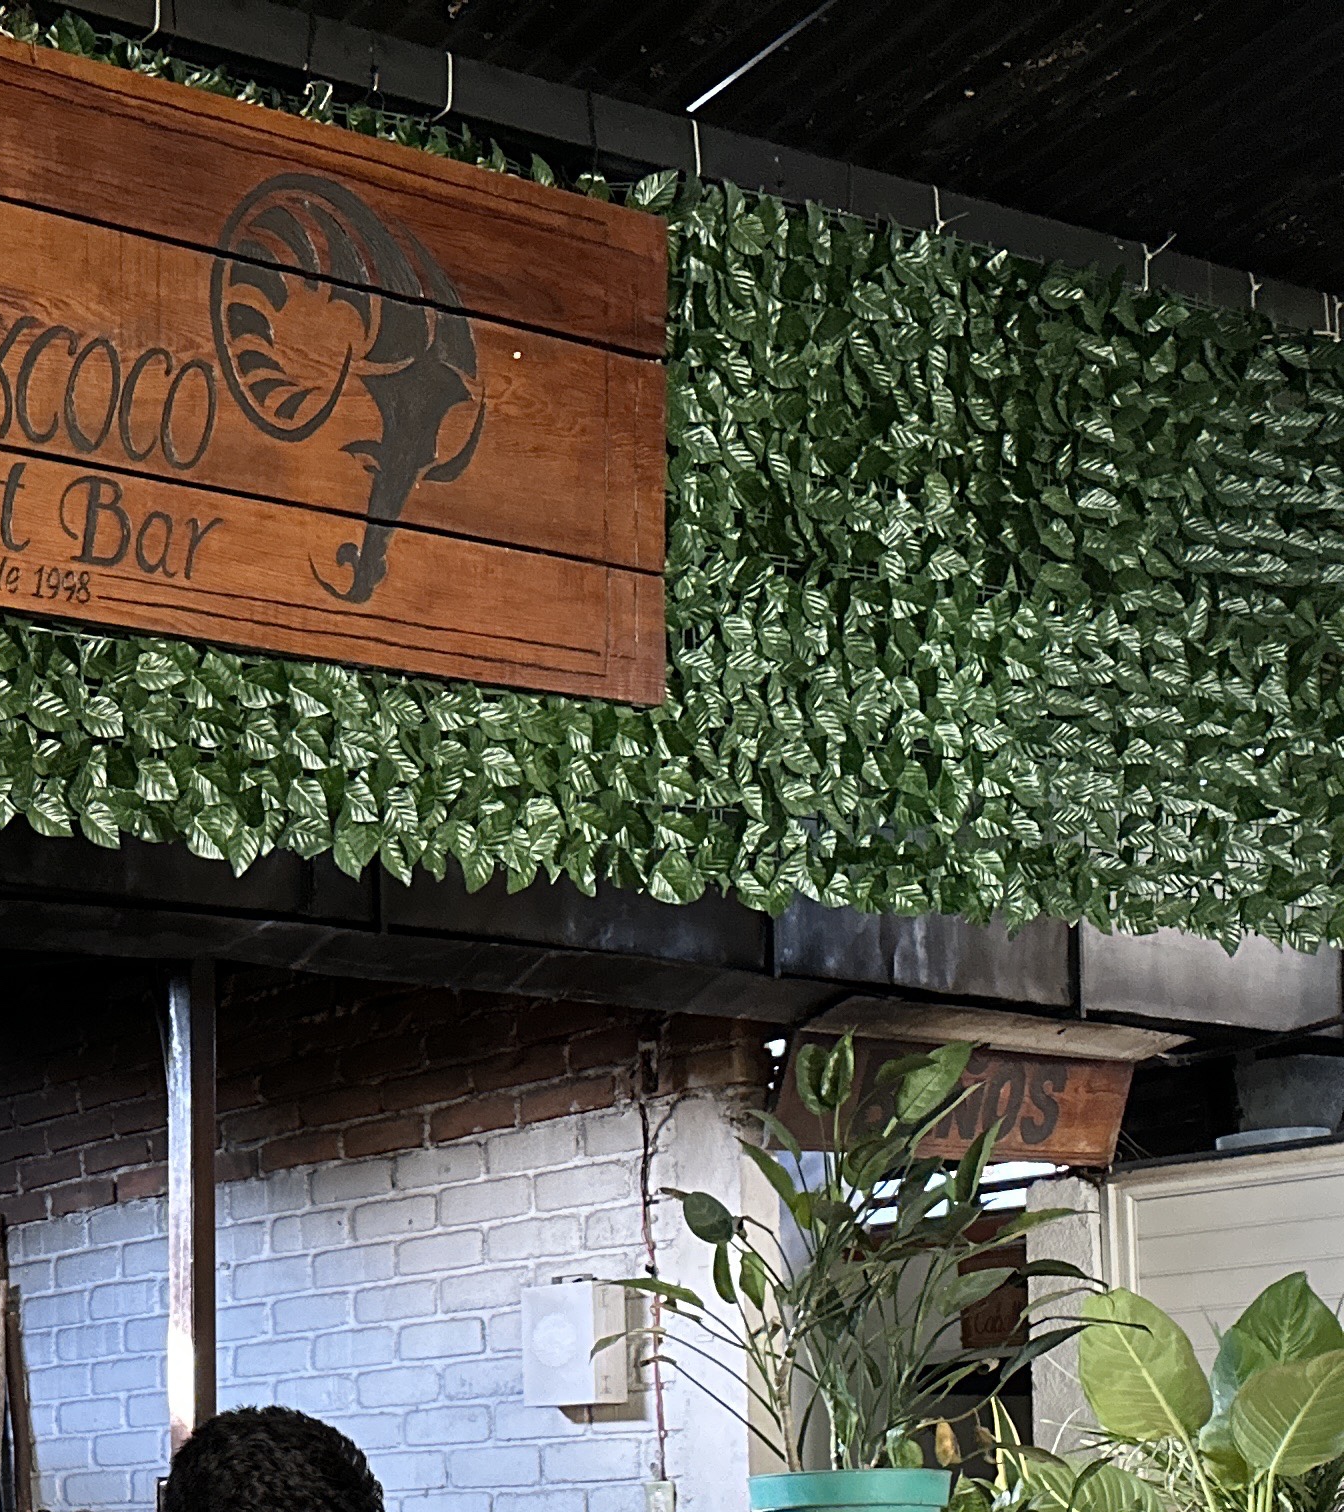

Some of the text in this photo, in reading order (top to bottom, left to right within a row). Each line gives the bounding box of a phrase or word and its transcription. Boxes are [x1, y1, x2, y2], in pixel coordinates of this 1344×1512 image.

[60, 473, 223, 583] Bar
[31, 564, 91, 604] 1998
[850, 1054, 1069, 1145] BÑOS
